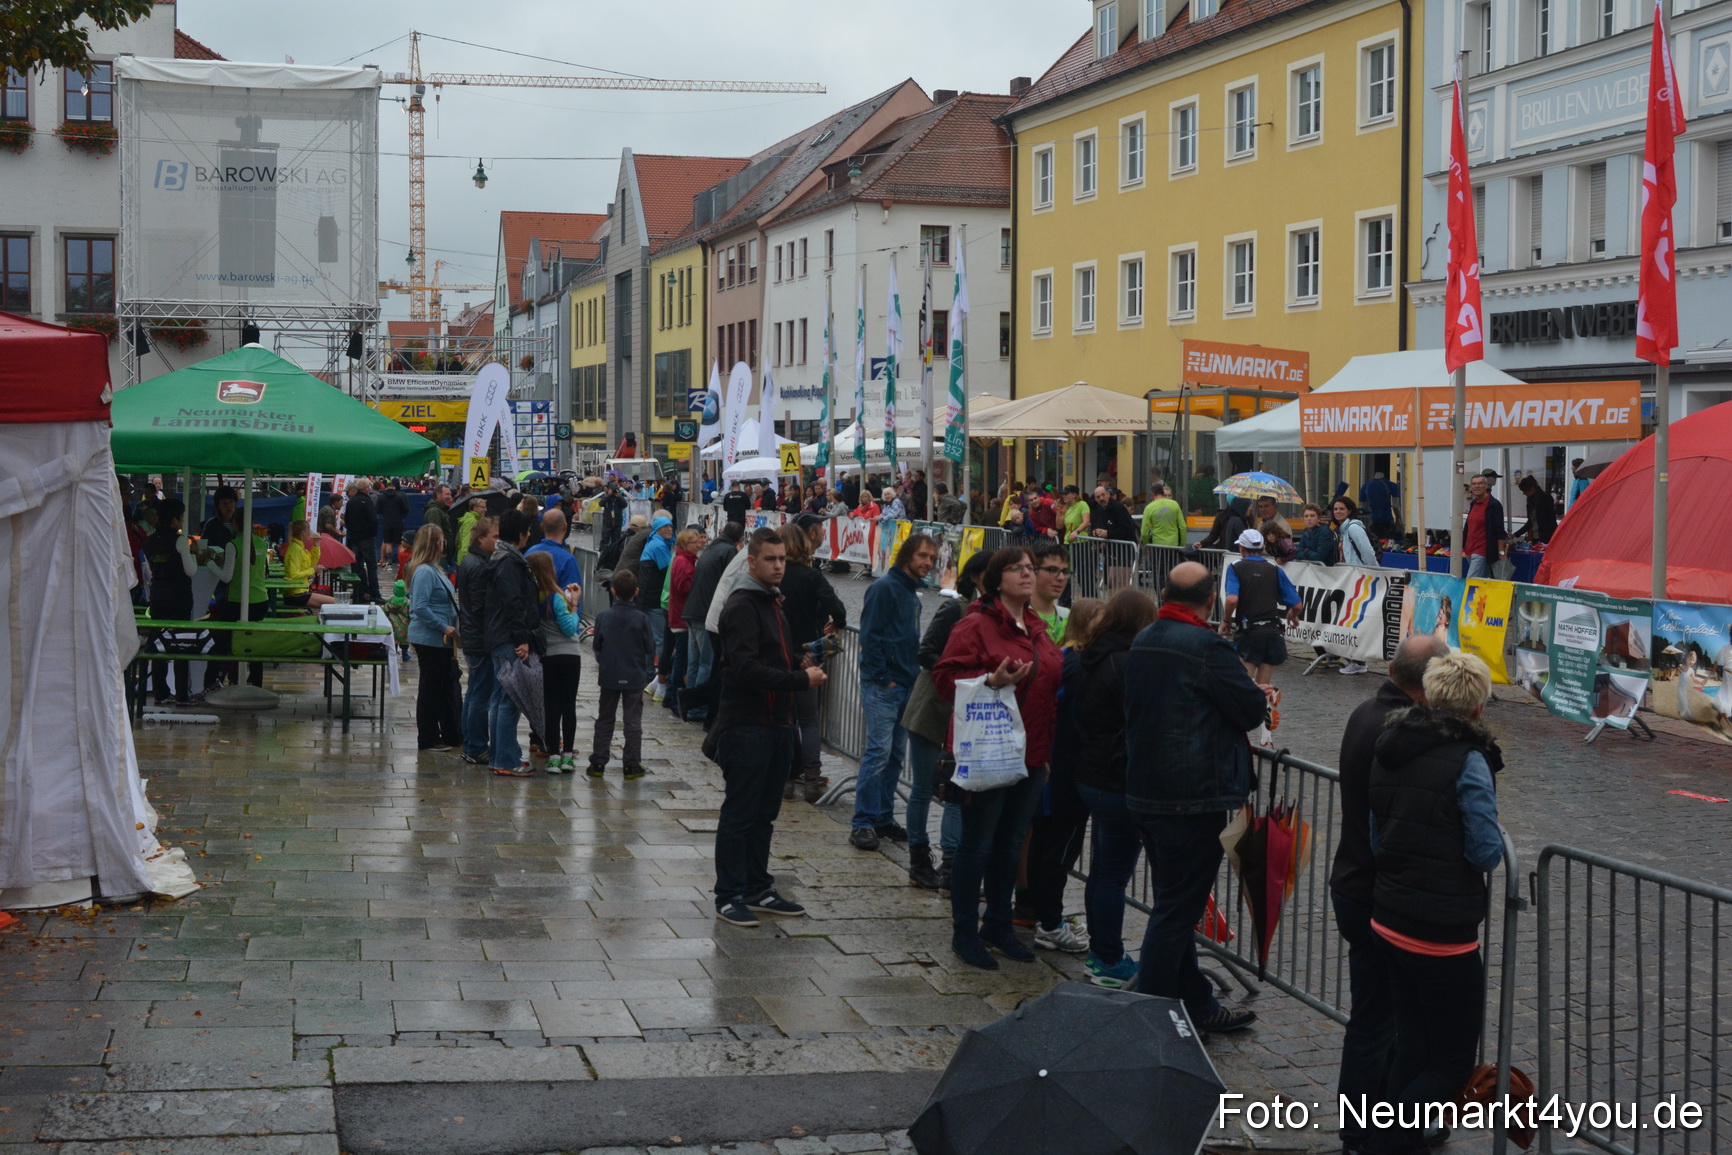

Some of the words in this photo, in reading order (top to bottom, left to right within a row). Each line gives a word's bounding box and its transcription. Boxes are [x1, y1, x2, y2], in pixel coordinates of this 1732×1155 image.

[1521, 90, 1590, 131] BRILLEN
[195, 166, 308, 184] BAROWSKI
[315, 168, 347, 184] AG
[196, 184, 261, 192] Veranstaltungs-
[281, 186, 345, 194] Mediensysteme
[196, 271, 315, 285] www.barowski-ag.de
[1490, 307, 1572, 344] BRILLEN
[1186, 351, 1304, 381] RUNMARKT.DE
[406, 379, 467, 387] EfficientDynamics
[178, 408, 297, 421] Neumarkter
[401, 405, 436, 417] ZIEL
[1303, 404, 1408, 433] RUNMARKT.DE
[152, 416, 315, 434] Lammsbräu
[727, 436, 737, 464] Audi
[785, 452, 797, 467] A
[474, 466, 486, 481] A
[1484, 615, 1504, 628] KANN
[1558, 623, 1573, 633] MATHI
[1574, 626, 1598, 636] HOFFER
